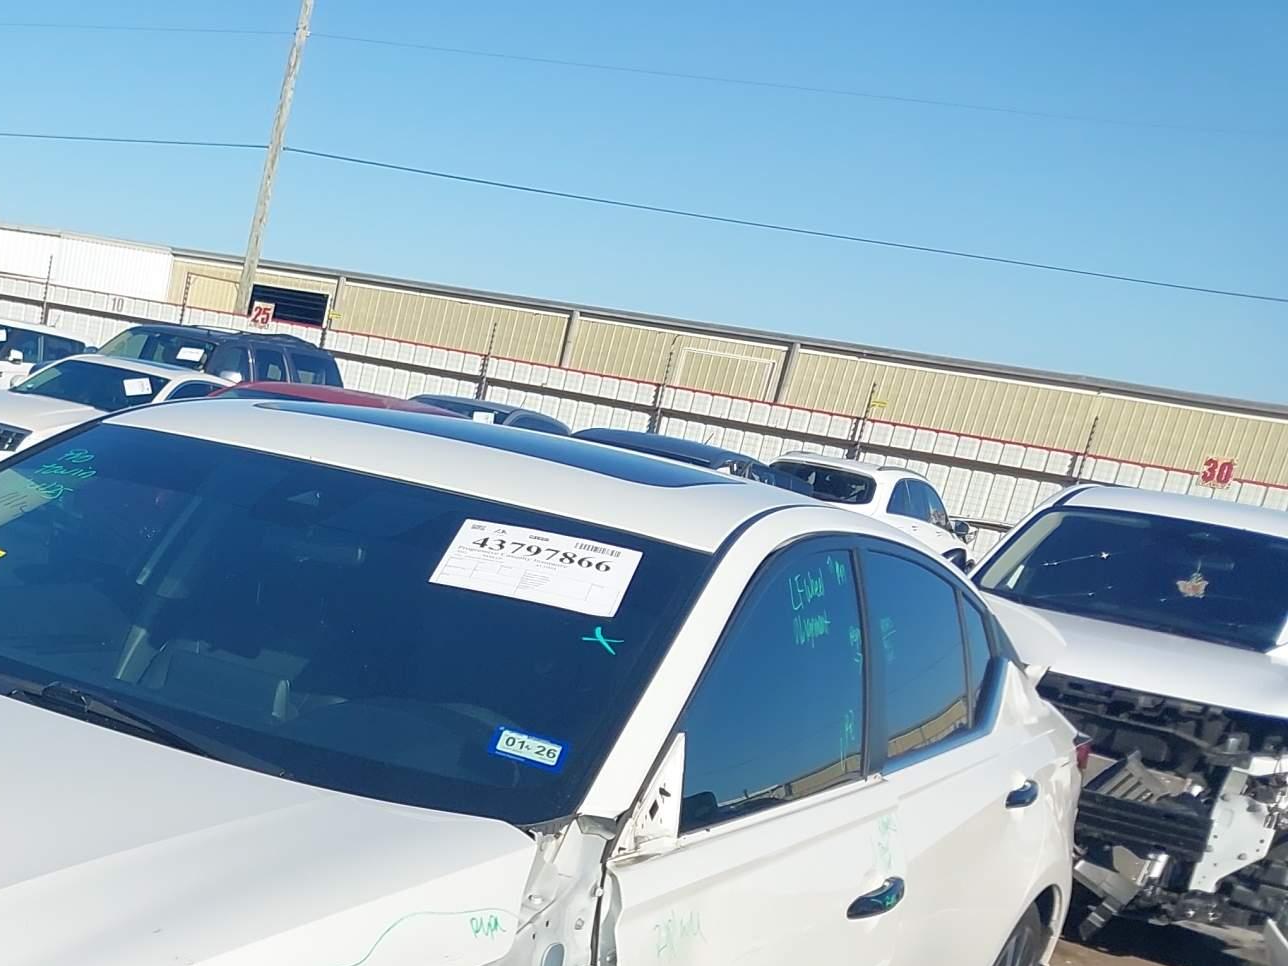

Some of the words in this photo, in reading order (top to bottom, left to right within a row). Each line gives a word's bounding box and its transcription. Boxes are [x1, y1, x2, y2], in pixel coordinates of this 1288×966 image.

[112, 297, 124, 312] 10
[251, 306, 272, 324] 25
[1202, 459, 1234, 484] 30
[472, 537, 612, 572] 43797866
[505, 736, 526, 750] 01
[533, 745, 558, 759] 26
